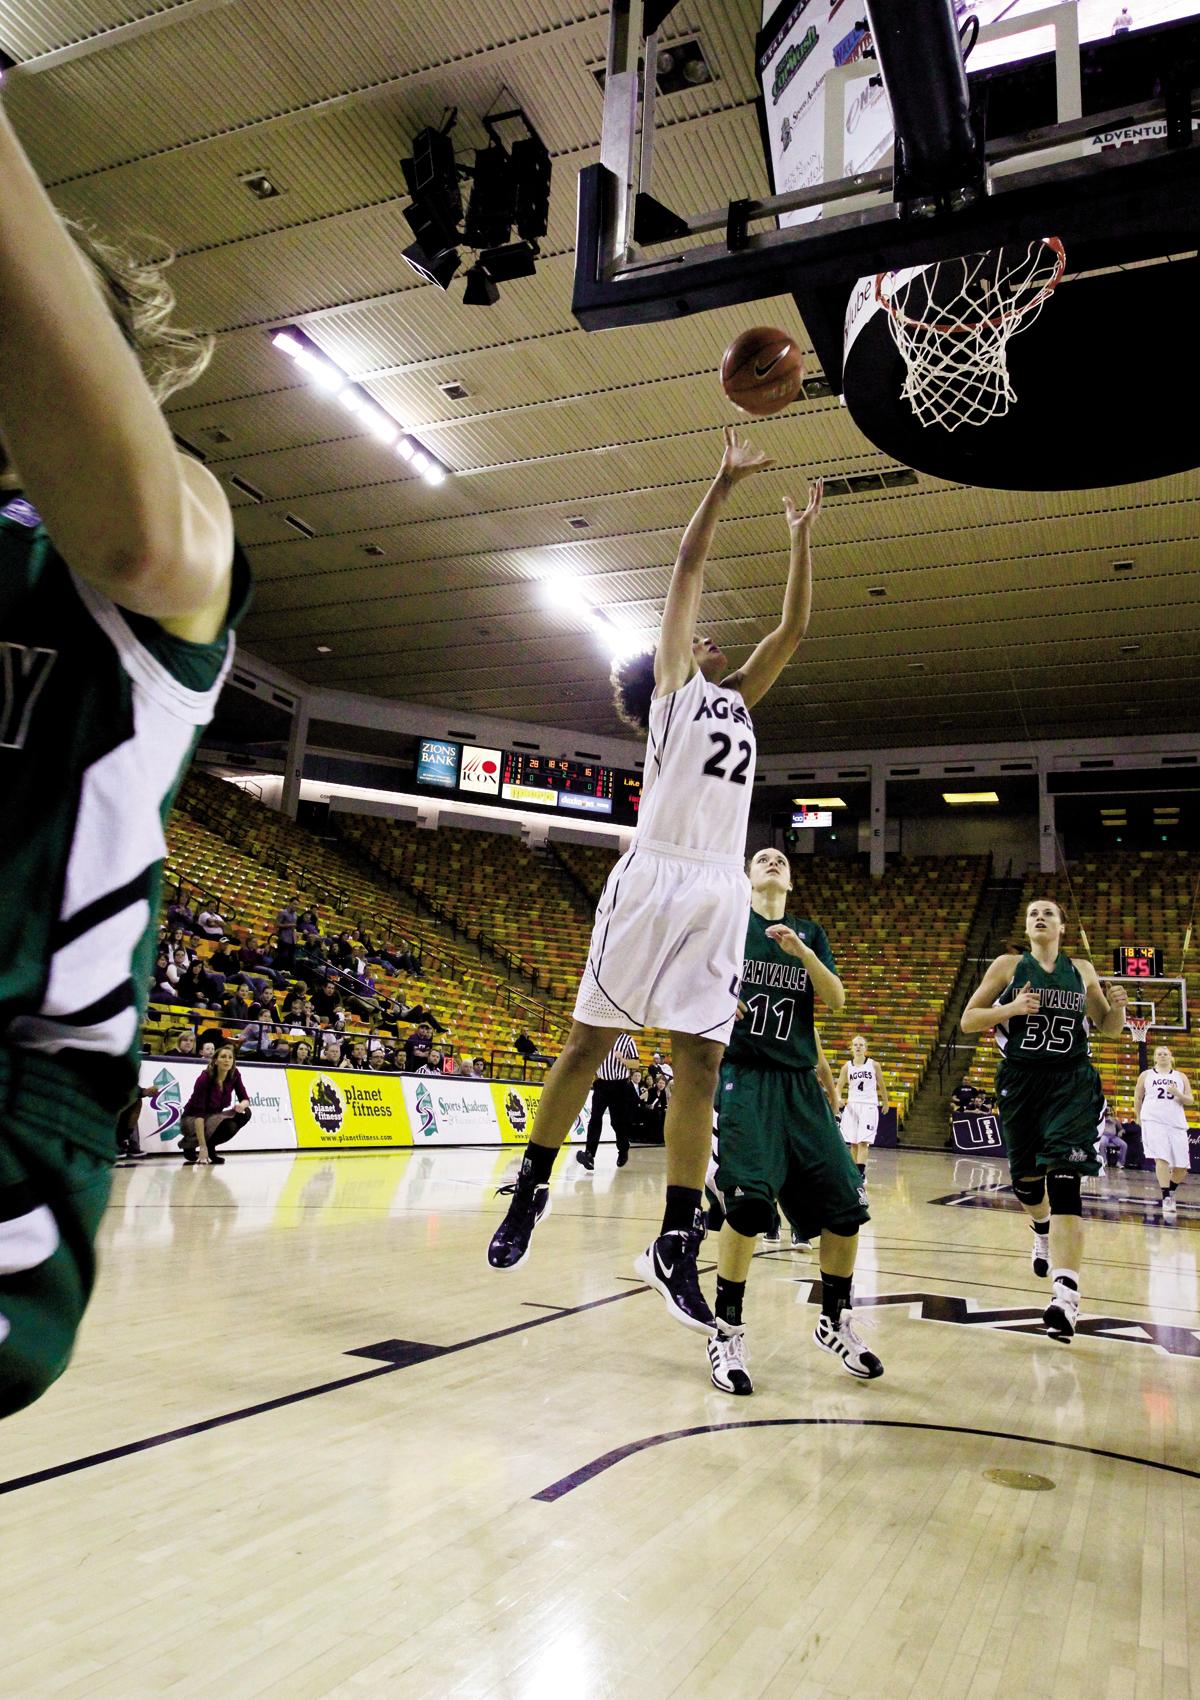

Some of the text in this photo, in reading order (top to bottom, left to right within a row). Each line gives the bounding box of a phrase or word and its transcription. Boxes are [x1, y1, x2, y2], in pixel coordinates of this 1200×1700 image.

[422, 742, 456, 756] ZIONS
[421, 752, 455, 767] BANK
[702, 731, 752, 785] 22
[462, 771, 496, 784] ICON
[1127, 958, 1150, 977] 25
[766, 962, 808, 993] VALLE
[747, 993, 795, 1041] 11
[1020, 1014, 1075, 1053] 35
[849, 1071, 873, 1081] AGGIES
[857, 1081, 865, 1092] 4
[344, 1085, 383, 1105] planet
[313, 1104, 336, 1115] planet
[352, 1101, 392, 1117] fitness
[438, 1096, 489, 1116] Sports Academy
[320, 1133, 393, 1143] www.planetfitness.com
